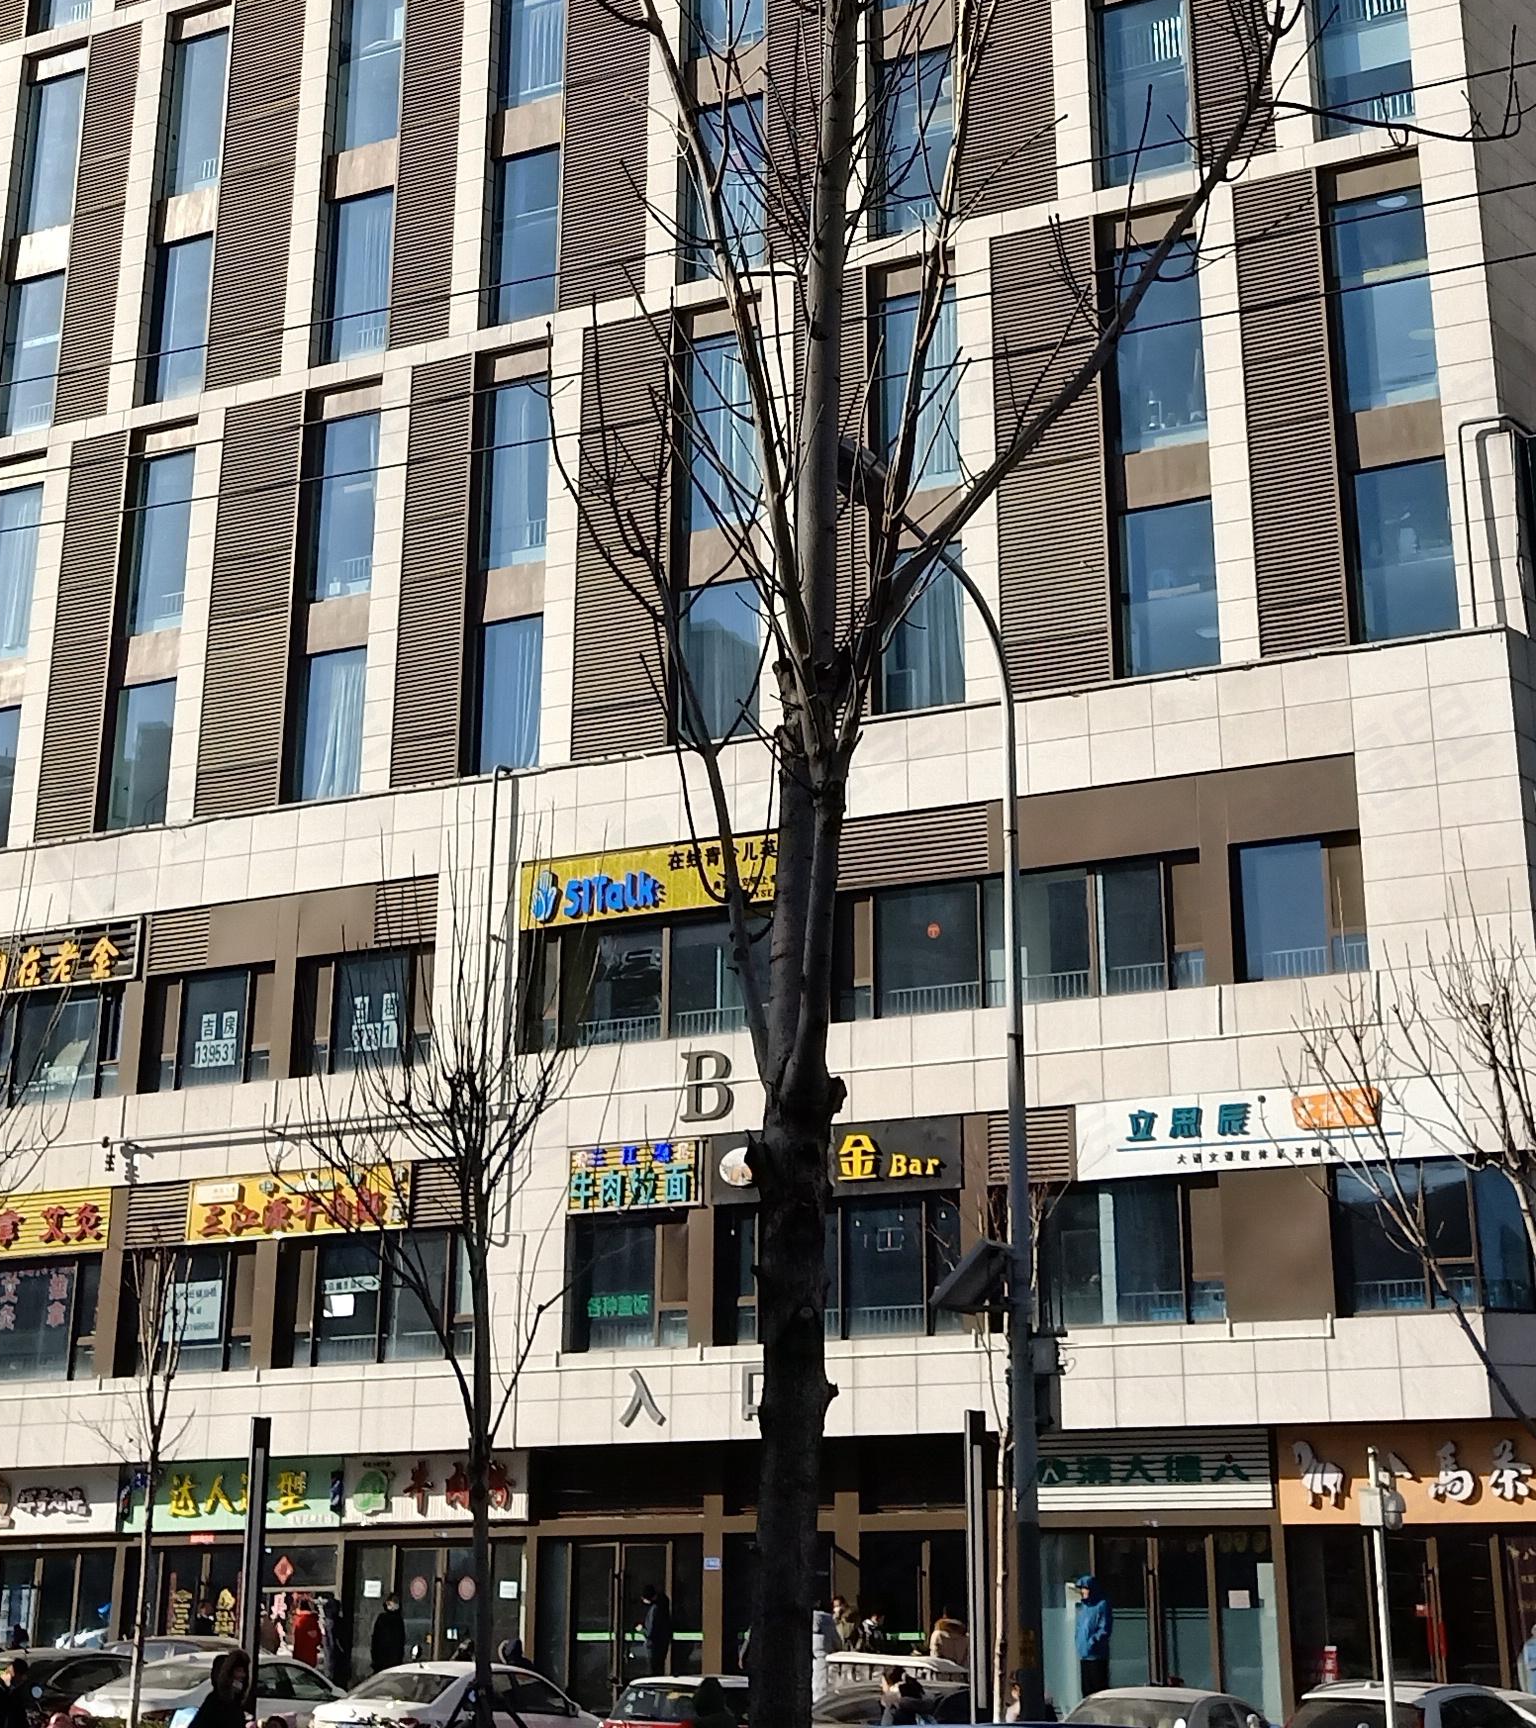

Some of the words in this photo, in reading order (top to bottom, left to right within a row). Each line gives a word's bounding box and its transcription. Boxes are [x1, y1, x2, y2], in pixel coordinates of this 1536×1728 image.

[667, 839, 779, 871] 在线青儿英
[564, 871, 660, 919] 51Talk
[203, 1015, 237, 1037] 吉房
[680, 1050, 734, 1123] B
[1125, 1102, 1252, 1142] 立思辰
[837, 1134, 878, 1181] 金
[888, 1152, 941, 1178] Bar
[569, 1163, 693, 1210] 牛肉拉面
